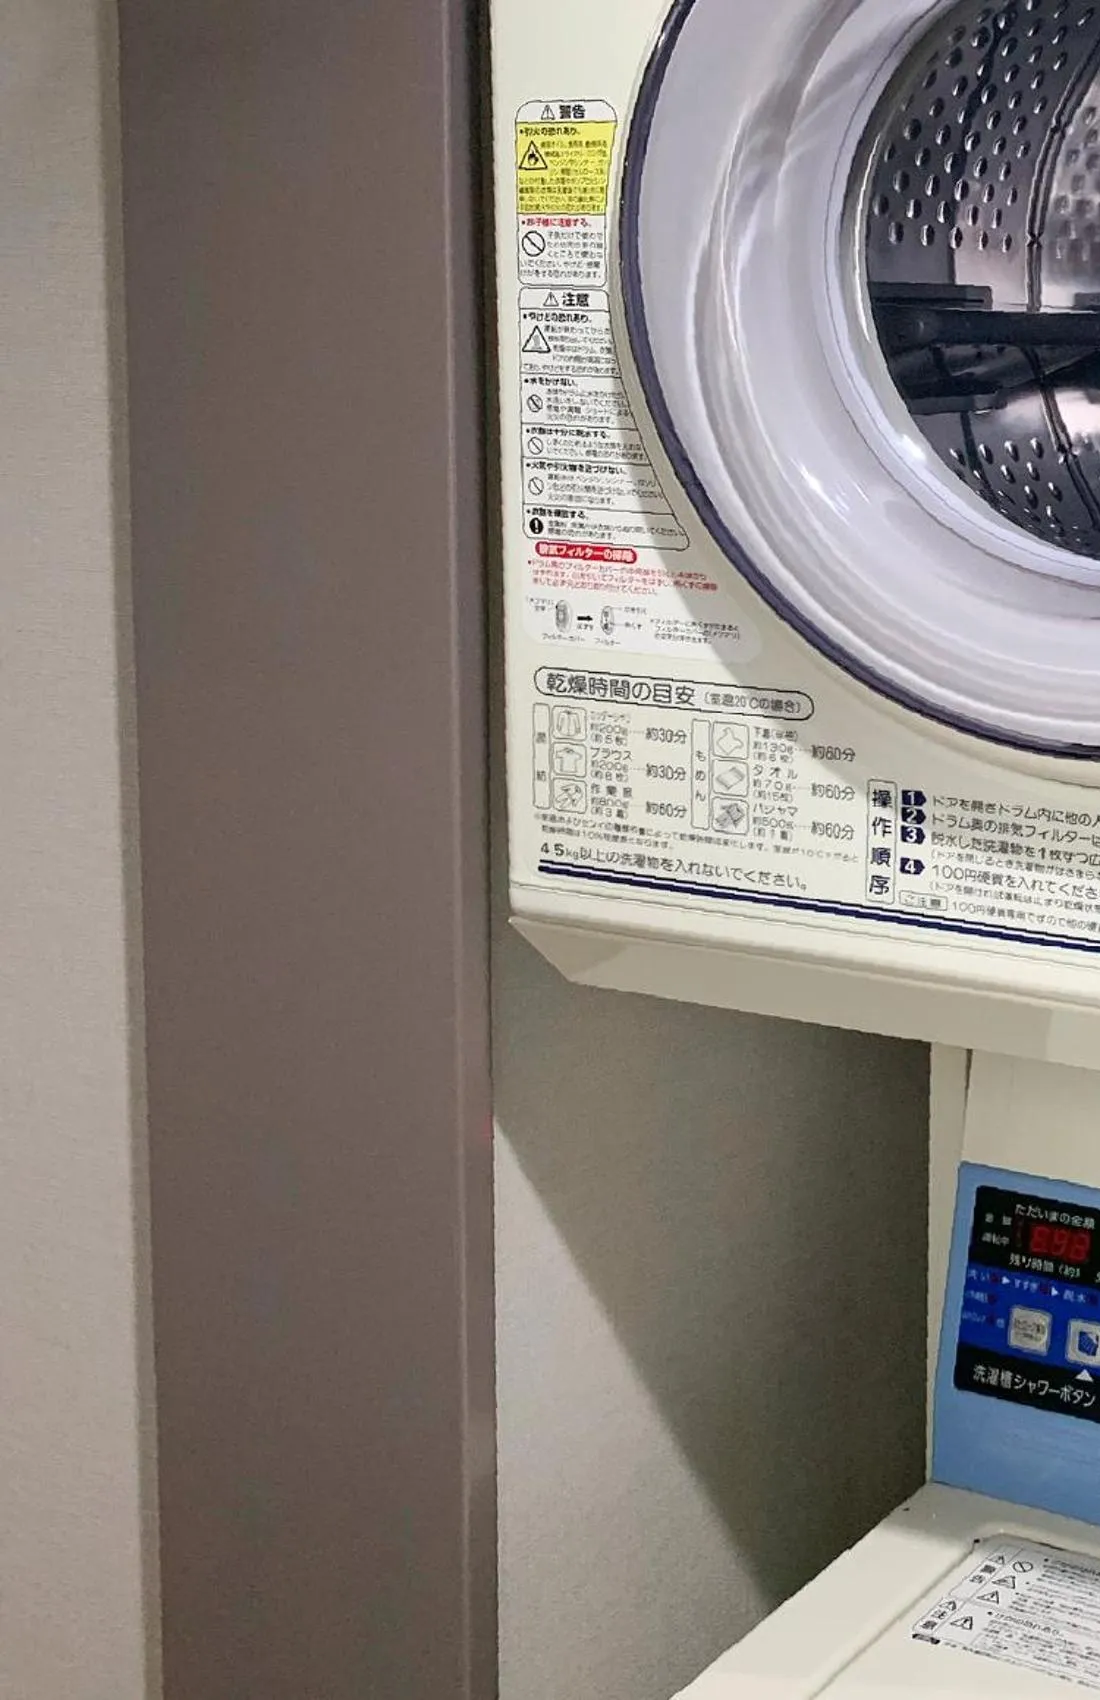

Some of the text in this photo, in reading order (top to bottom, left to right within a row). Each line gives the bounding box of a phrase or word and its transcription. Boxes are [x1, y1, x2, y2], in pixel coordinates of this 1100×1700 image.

[559, 104, 586, 119] 警告
[561, 292, 589, 308] 注意
[547, 673, 695, 706] 乾燥時間の目安
[645, 726, 688, 745] 約30分
[811, 744, 857, 763] 約60分
[645, 763, 688, 782] 約30分
[696, 750, 706, 802] もめん
[753, 765, 798, 780] タオル
[811, 783, 856, 802] 約60分
[905, 790, 918, 807] 1
[645, 801, 688, 819] 約60分
[905, 808, 918, 825] 2
[811, 821, 856, 841] 約60分
[904, 826, 918, 843] 3
[868, 788, 893, 897] 操作順序
[903, 858, 917, 875] 4
[1014, 1203, 1096, 1230] ただいまの金額
[972, 1363, 1096, 1408] 洗濯槽シャワーボタン
